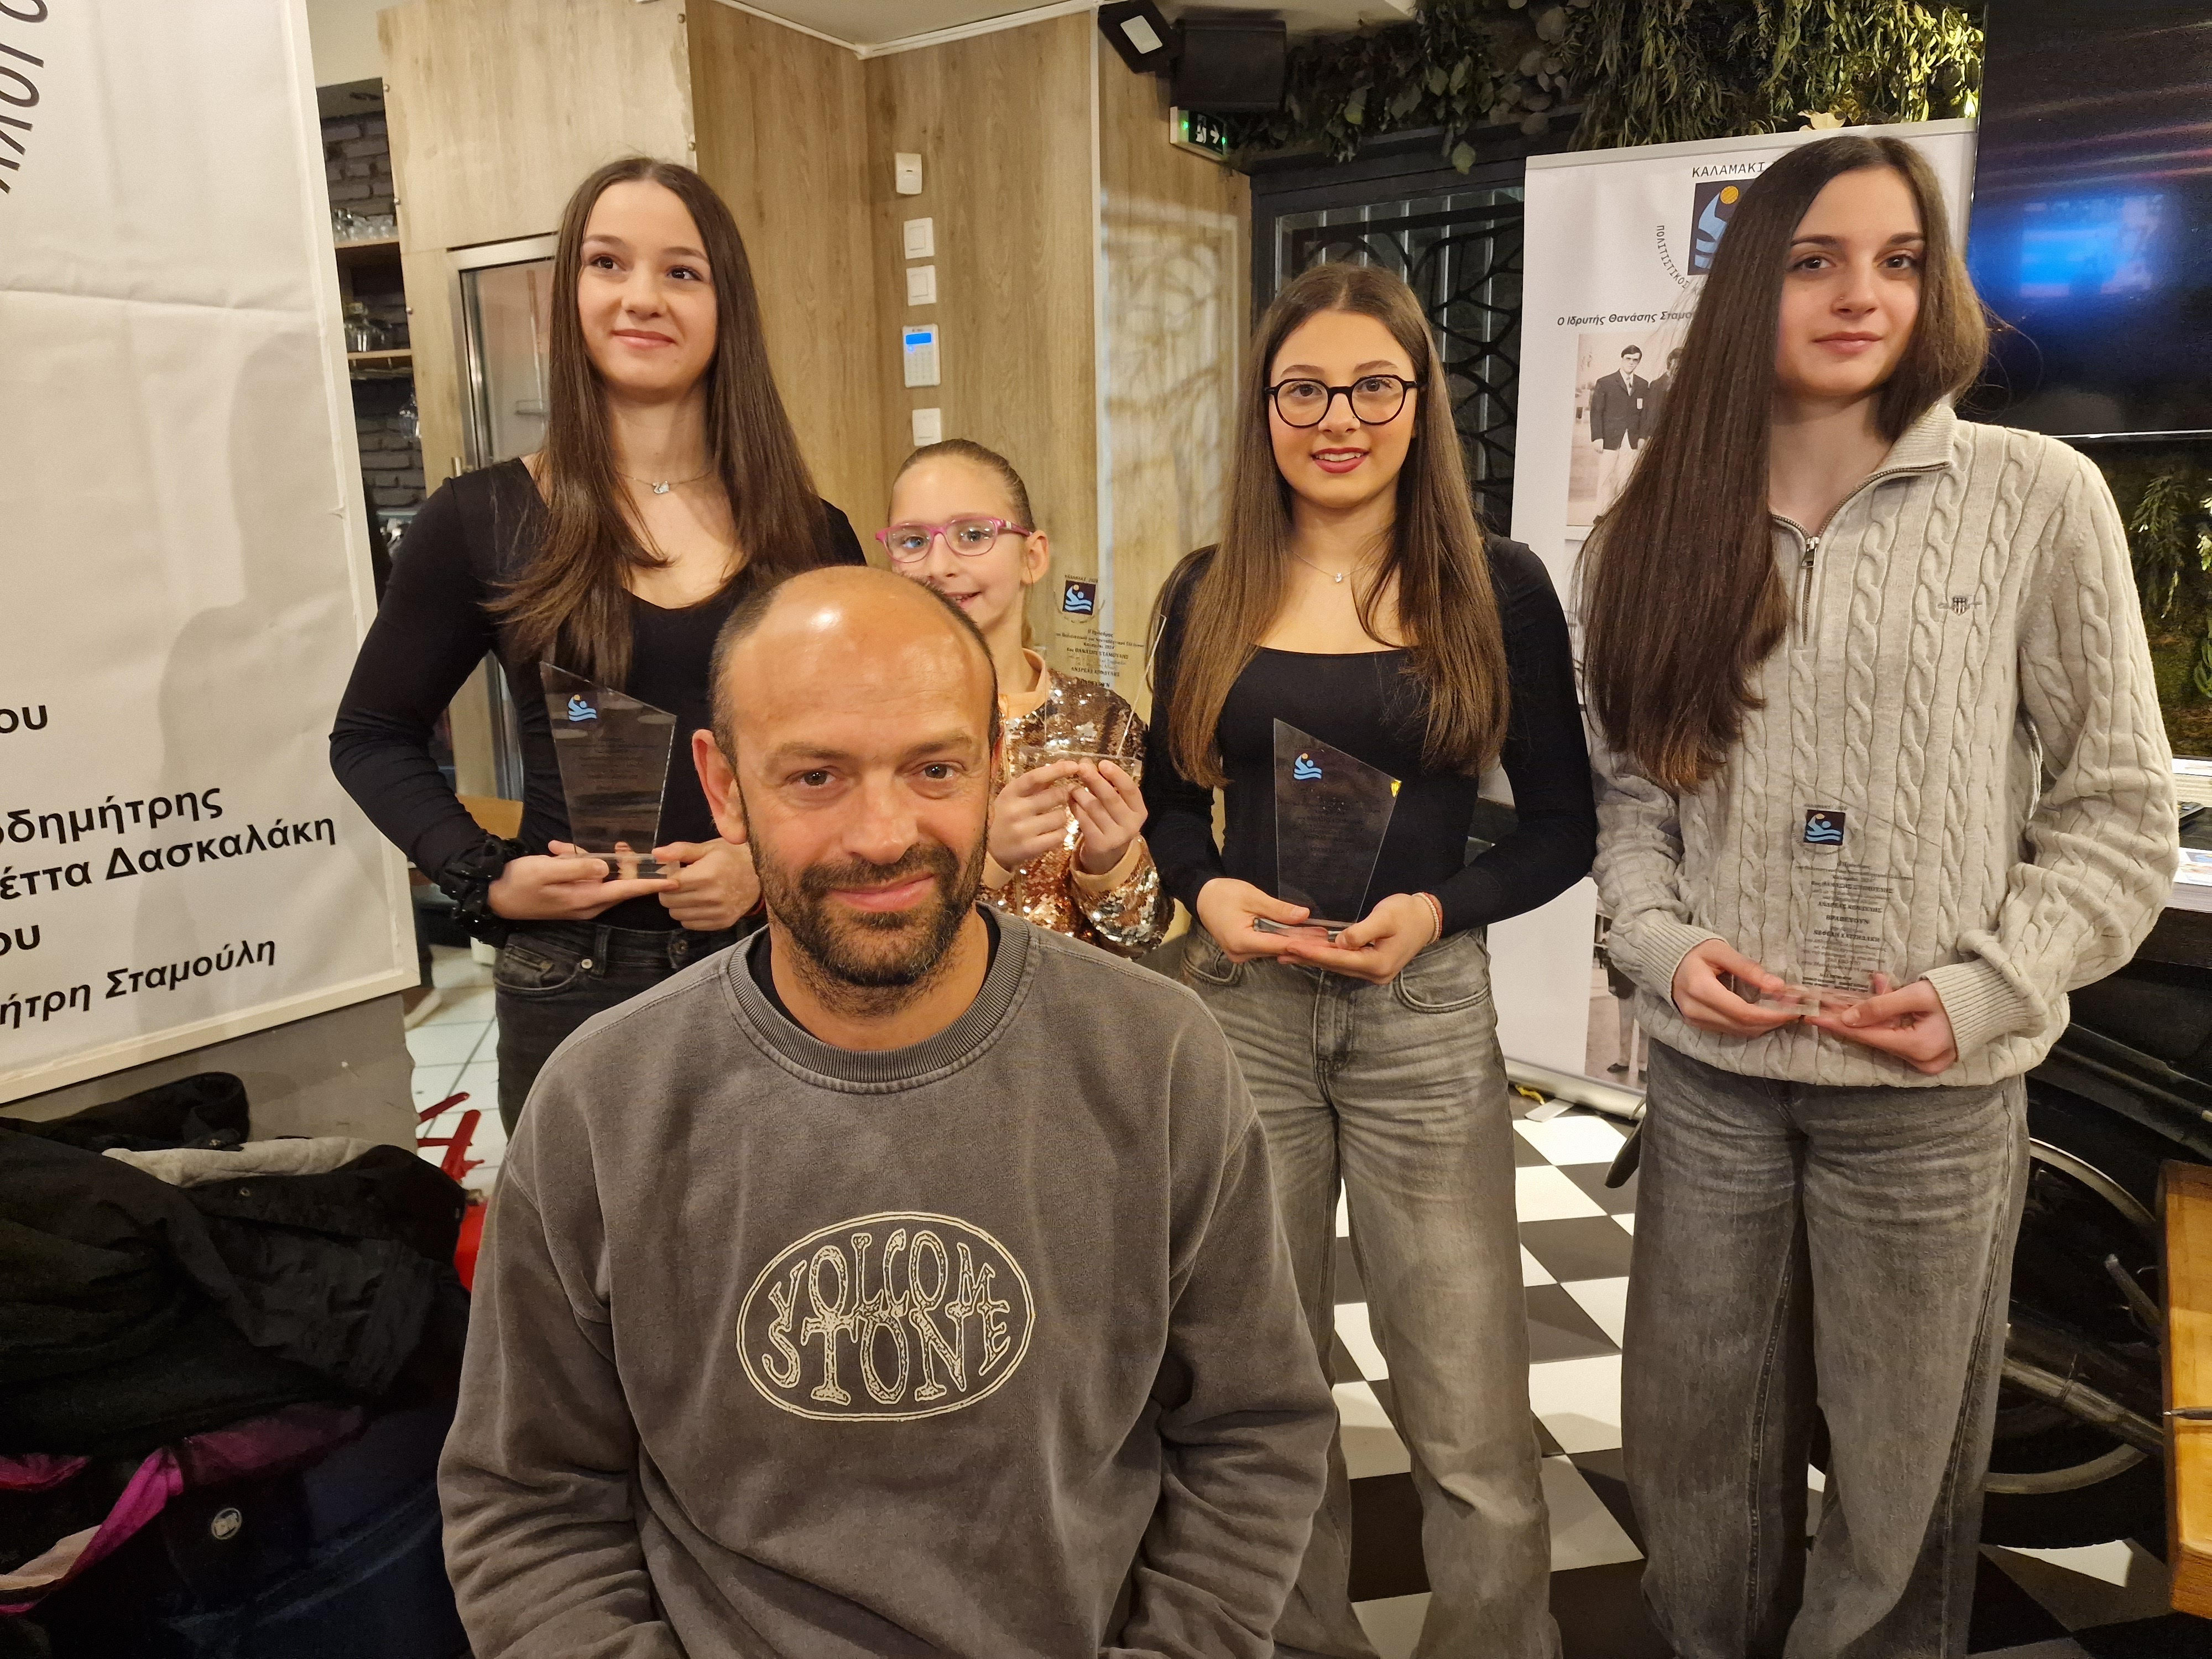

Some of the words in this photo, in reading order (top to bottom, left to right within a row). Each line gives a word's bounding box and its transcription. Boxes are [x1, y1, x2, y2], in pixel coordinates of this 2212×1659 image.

[1692, 161, 1765, 178] ΚΑΛΑΜΑΚΙ
[1656, 225, 1690, 289] ΠΟΛΙΤΙΣΤΙΚΟΣ
[1557, 317, 1564, 326] Ο
[1567, 314, 1606, 327] Ιδρυτής
[1608, 312, 1657, 324] Θανάσης
[0, 787, 223, 844] δημήτρης
[0, 865, 92, 900] έττα
[106, 817, 336, 880] Δασκαλάκη
[105, 940, 275, 999] Σταμούλη
[769, 1229, 1010, 1329] VOLCOM
[761, 1306, 1011, 1405] STONE
